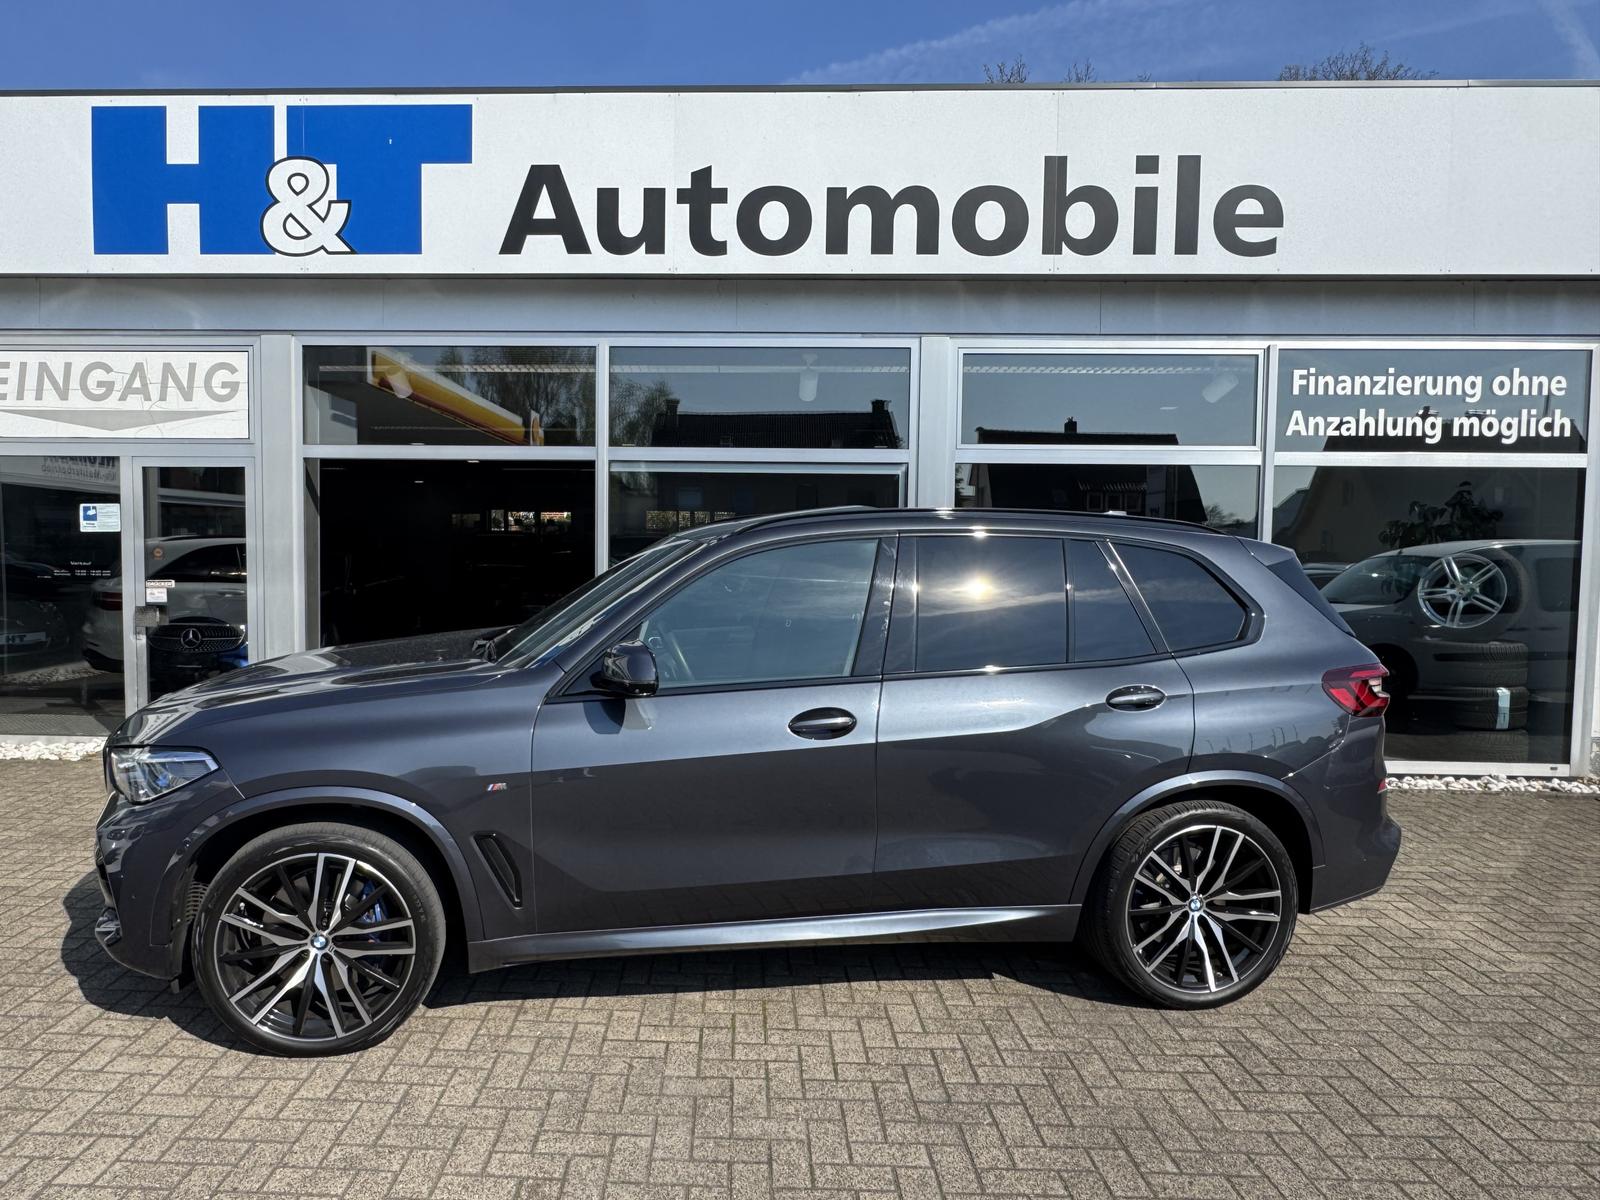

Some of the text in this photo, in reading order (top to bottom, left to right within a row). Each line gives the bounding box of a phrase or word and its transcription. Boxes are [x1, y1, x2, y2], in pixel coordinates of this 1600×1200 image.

[92, 104, 1285, 257] H&T Automobile
[1291, 367, 1567, 403] Finanzierung ohne
[1285, 408, 1571, 445] Anzahlung möglich
